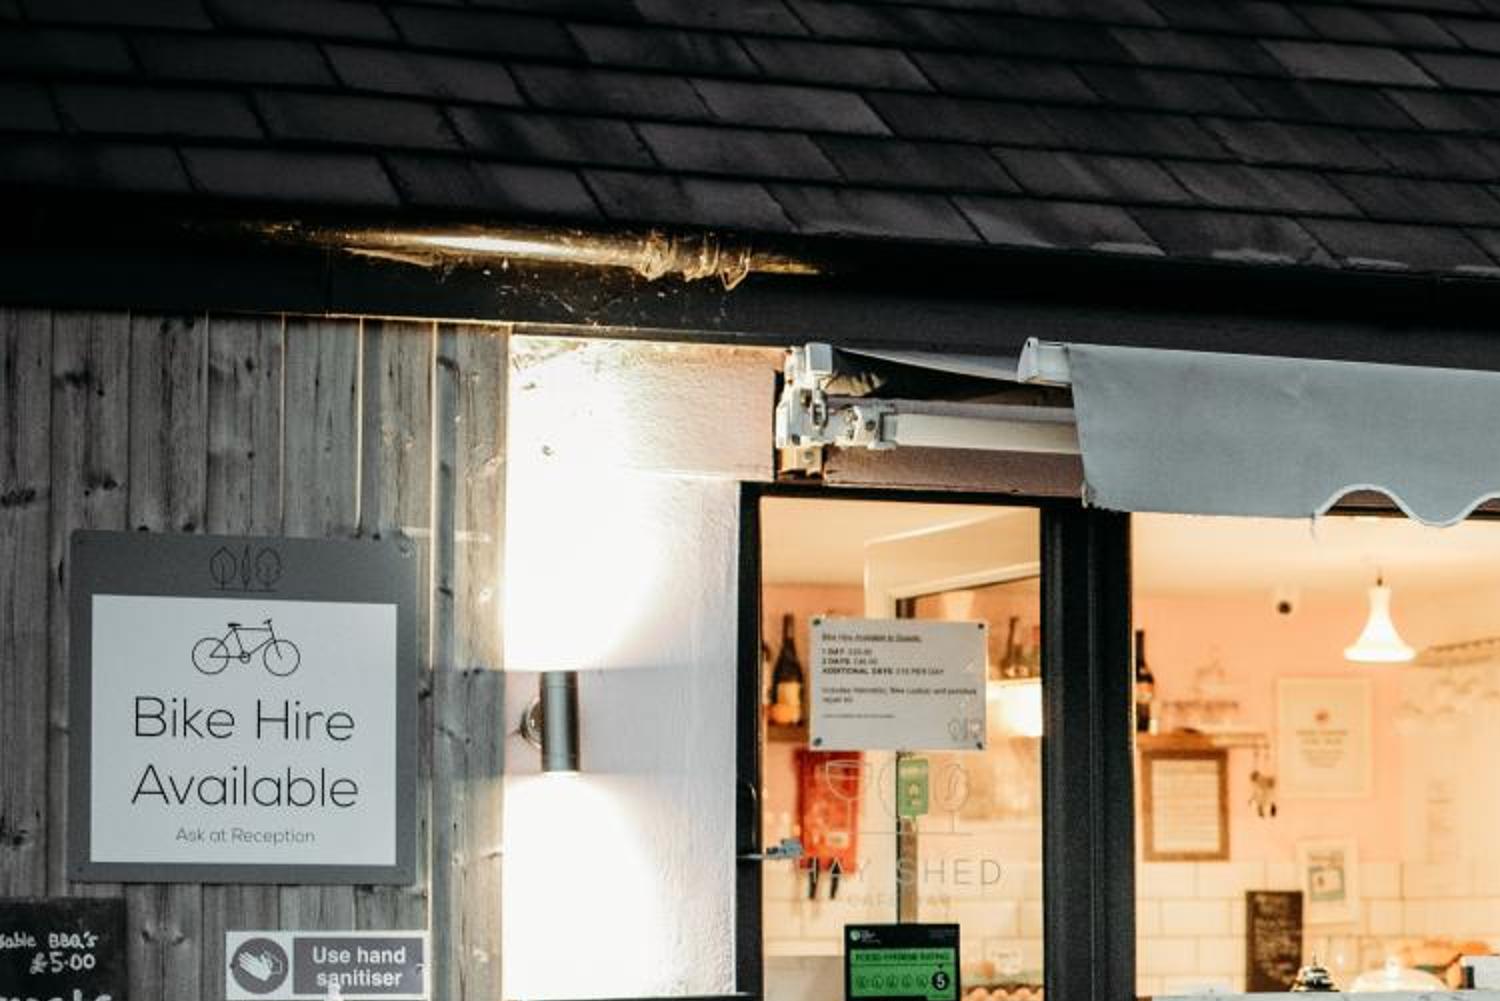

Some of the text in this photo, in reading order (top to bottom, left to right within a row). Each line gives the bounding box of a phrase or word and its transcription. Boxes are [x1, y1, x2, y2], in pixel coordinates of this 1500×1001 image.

[134, 696, 355, 741] Bike Hire
[131, 763, 359, 808] Available
[176, 827, 315, 846] Ask at Reception
[312, 945, 407, 965] Use hand
[315, 969, 404, 989] sanitiser
[935, 973, 946, 989] 5
